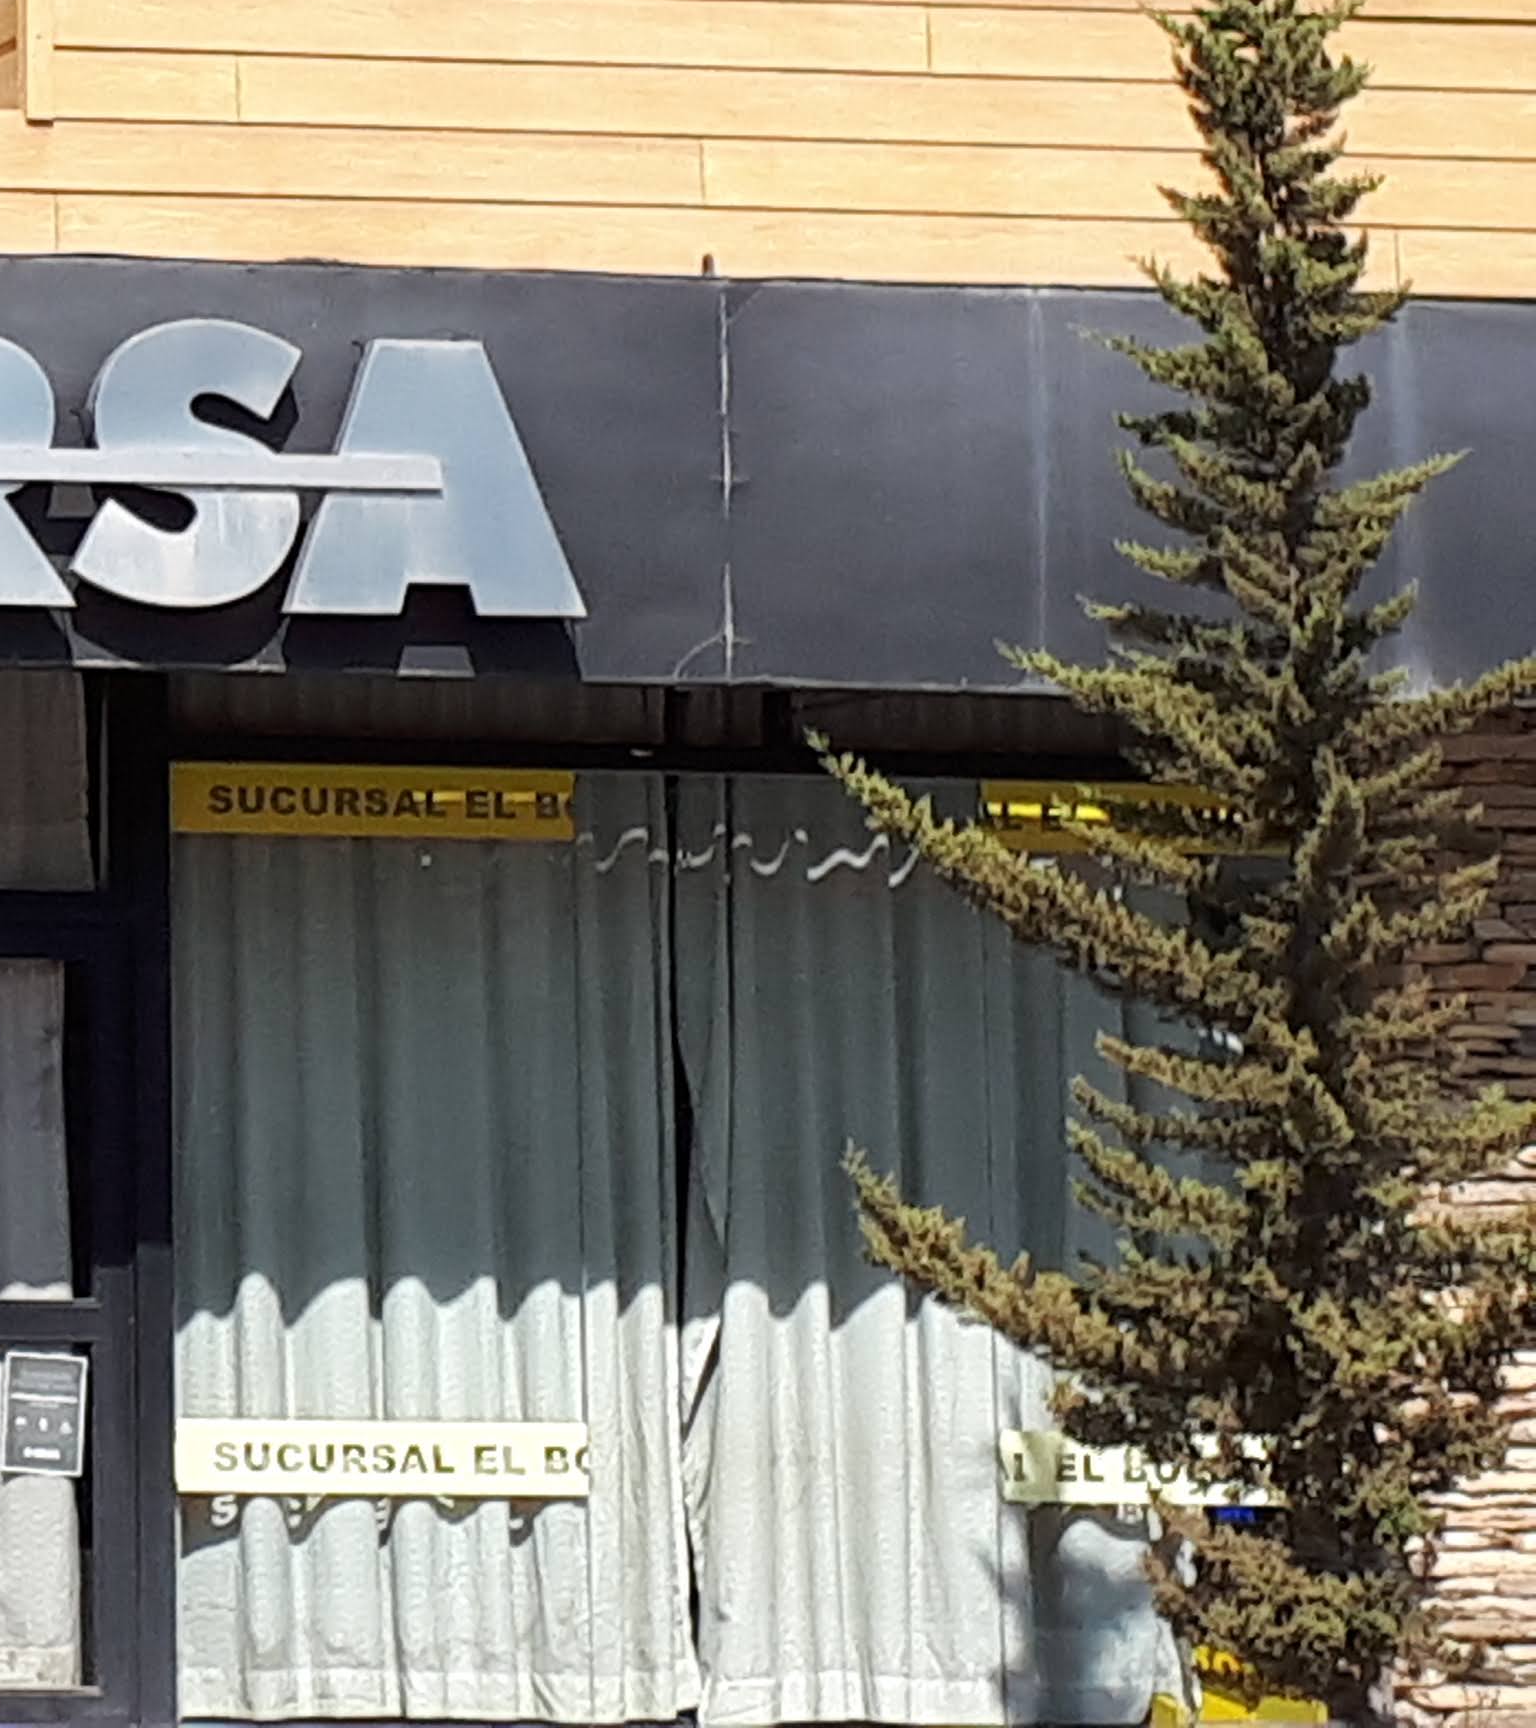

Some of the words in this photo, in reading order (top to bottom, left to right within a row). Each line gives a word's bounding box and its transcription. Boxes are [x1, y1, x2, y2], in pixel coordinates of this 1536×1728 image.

[208, 784, 447, 819] SUCURSAL
[464, 790, 517, 820] EL
[213, 1441, 456, 1474] SUCURSAL
[473, 1445, 527, 1476] EL
[1055, 1453, 1105, 1483] EL
